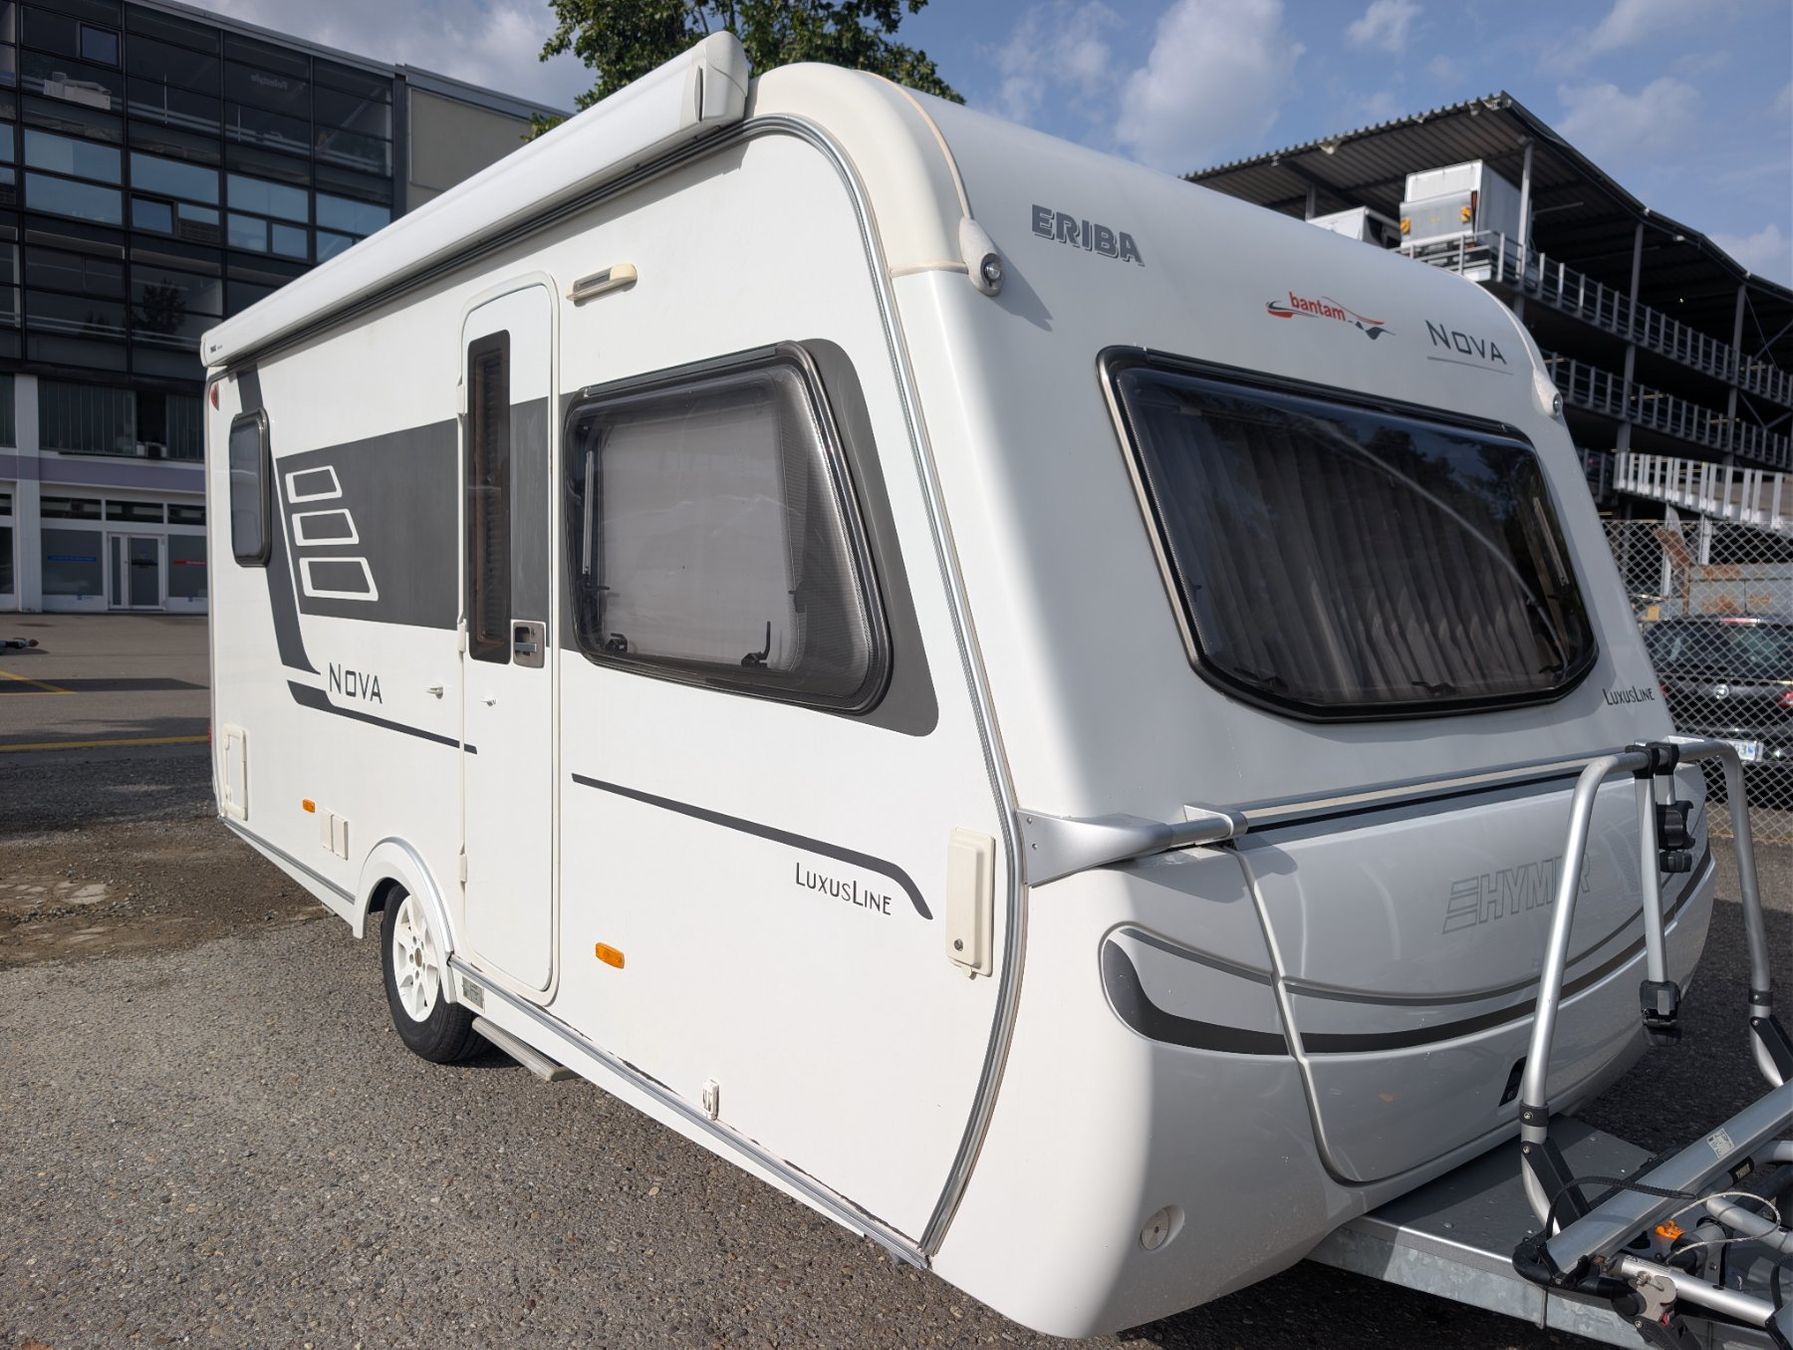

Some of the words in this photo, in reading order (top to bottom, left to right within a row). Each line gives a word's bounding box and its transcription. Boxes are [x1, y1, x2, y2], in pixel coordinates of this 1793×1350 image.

[1031, 203, 1146, 267] ERIBA
[1289, 291, 1346, 322] bantam
[1424, 319, 1508, 365] NOVA
[329, 661, 383, 705] NOVA
[1478, 852, 1591, 925] HYMR
